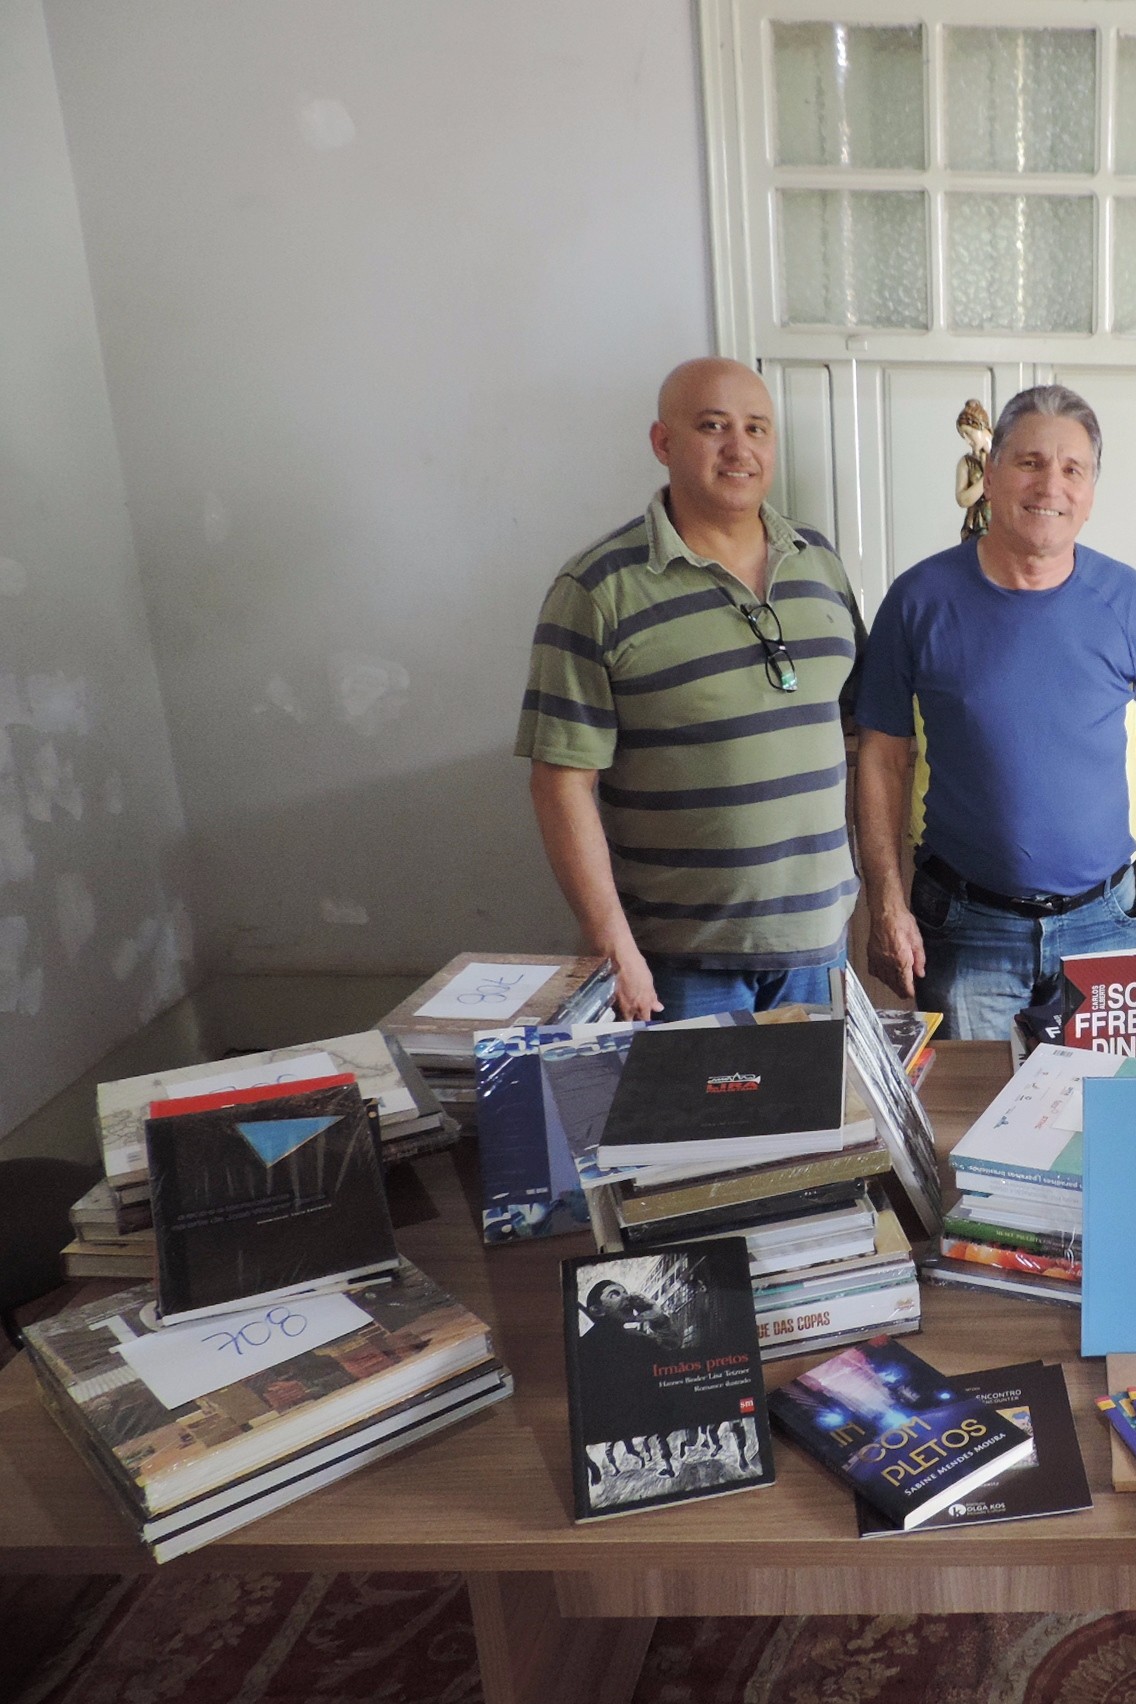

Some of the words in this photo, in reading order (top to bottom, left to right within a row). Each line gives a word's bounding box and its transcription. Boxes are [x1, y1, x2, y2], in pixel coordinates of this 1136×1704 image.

[1091, 985, 1099, 1011] CARLOS
[201, 1307, 308, 1354] 708
[773, 1318, 794, 1336] DAS
[797, 1311, 831, 1331] COPAS
[652, 1360, 701, 1377] Irmãos
[705, 1353, 750, 1372] pretos
[740, 1399, 754, 1408] sm
[828, 1422, 866, 1447] IN
[860, 1415, 931, 1463] COM
[882, 1418, 987, 1486] PLETOS
[904, 1473, 938, 1496] SABINE
[937, 1451, 974, 1477] MENDES
[973, 1432, 1006, 1453] MOURA
